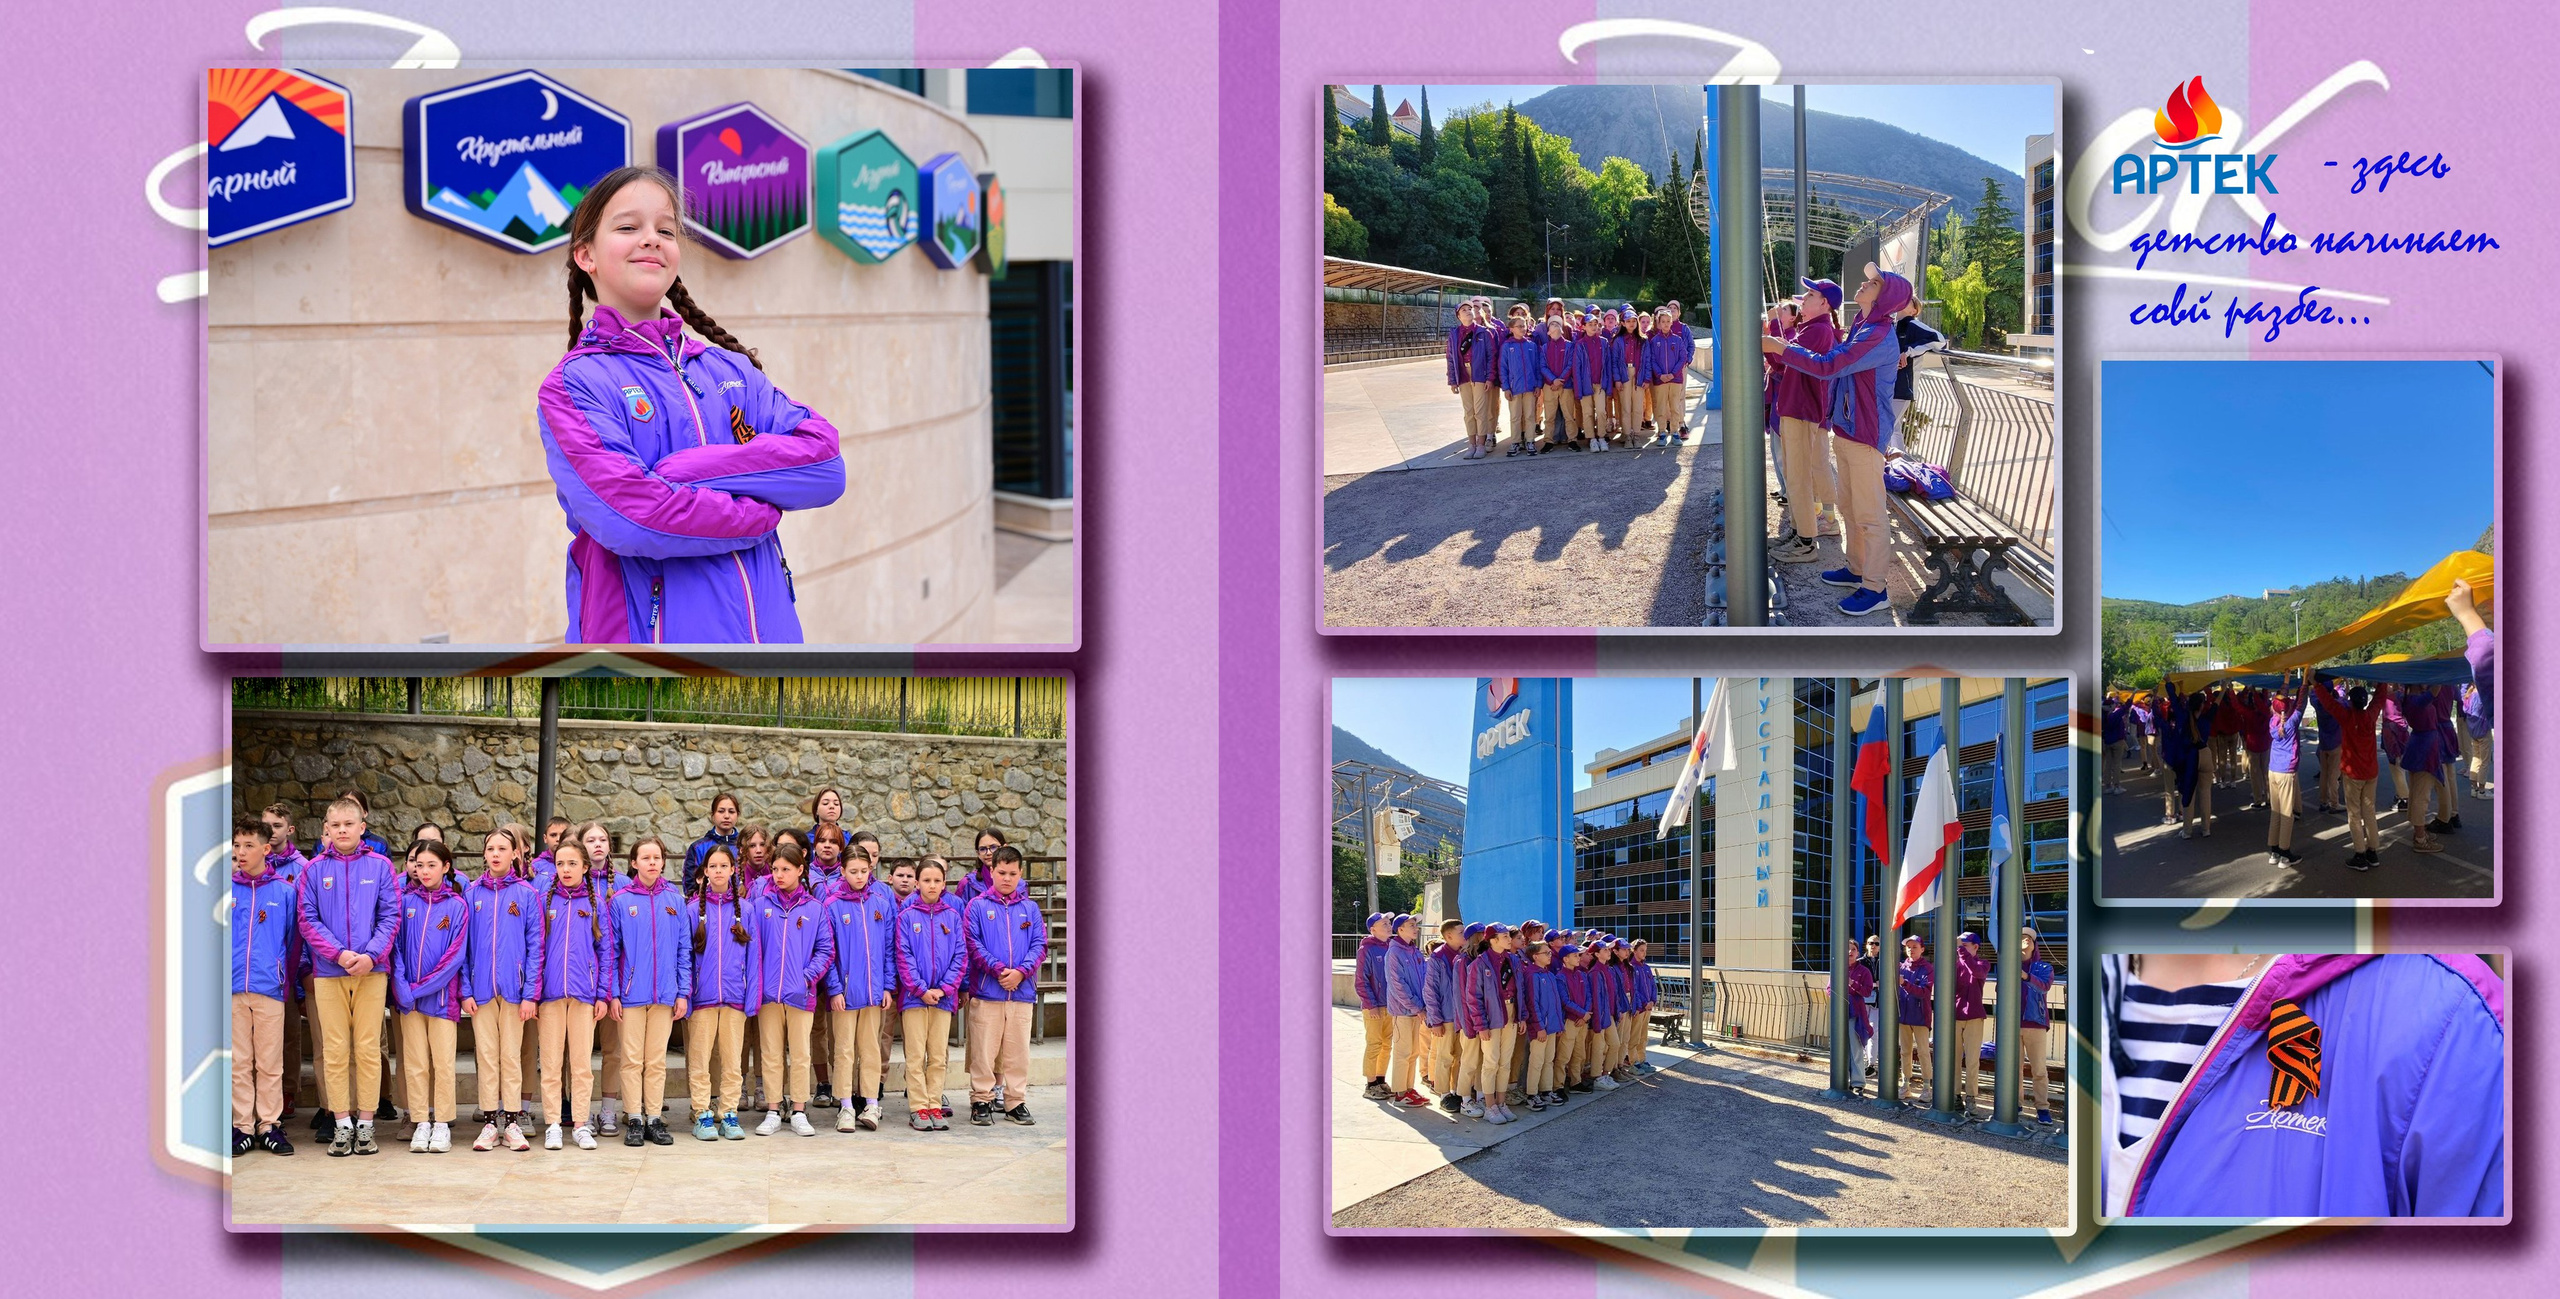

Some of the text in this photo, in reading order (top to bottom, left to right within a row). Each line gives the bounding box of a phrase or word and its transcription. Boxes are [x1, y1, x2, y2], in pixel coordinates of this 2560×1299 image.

[456, 123, 583, 168] Хрустальный
[208, 160, 297, 203] арный
[1477, 708, 1531, 760] АРТЕК
[1757, 677, 1771, 909] РУСТАЛЬНЫЙ
[2245, 1100, 2327, 1133] Артек
